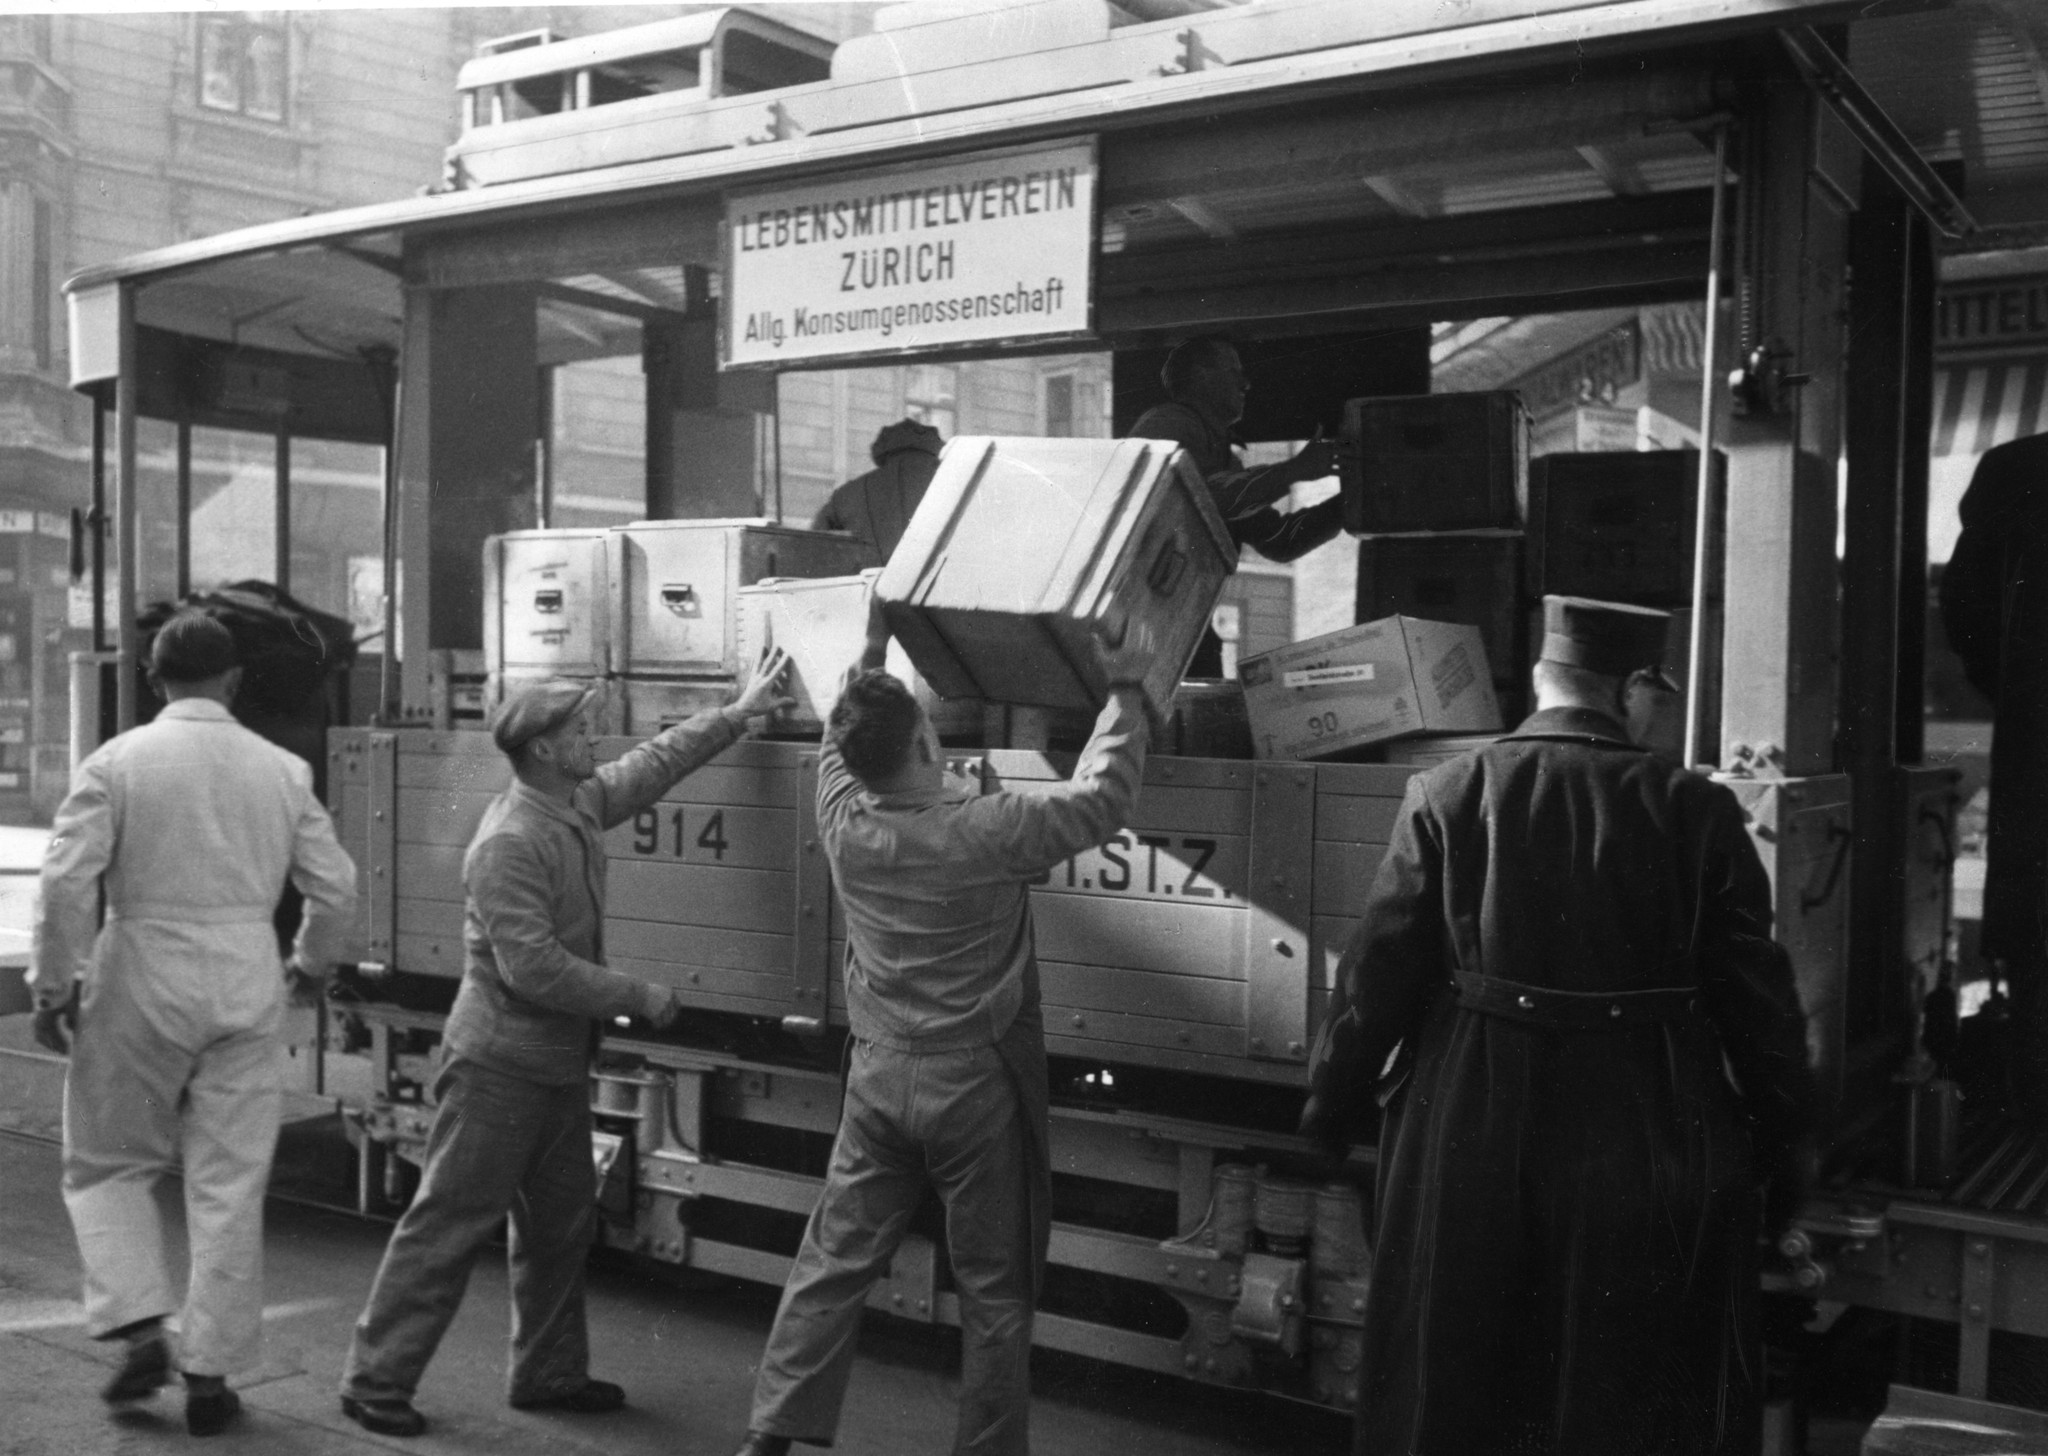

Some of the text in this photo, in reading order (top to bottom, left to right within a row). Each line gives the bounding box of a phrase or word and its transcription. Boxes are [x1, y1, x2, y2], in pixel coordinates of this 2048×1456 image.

[740, 166, 1076, 252] LEBENSMITTELVEREIN
[839, 239, 955, 293] ZÜRICH
[744, 276, 1064, 348] Allg. Konsumgenossenschaft
[1939, 287, 2048, 338] ITTEL
[1307, 710, 1339, 738] 90
[633, 807, 728, 860] 914
